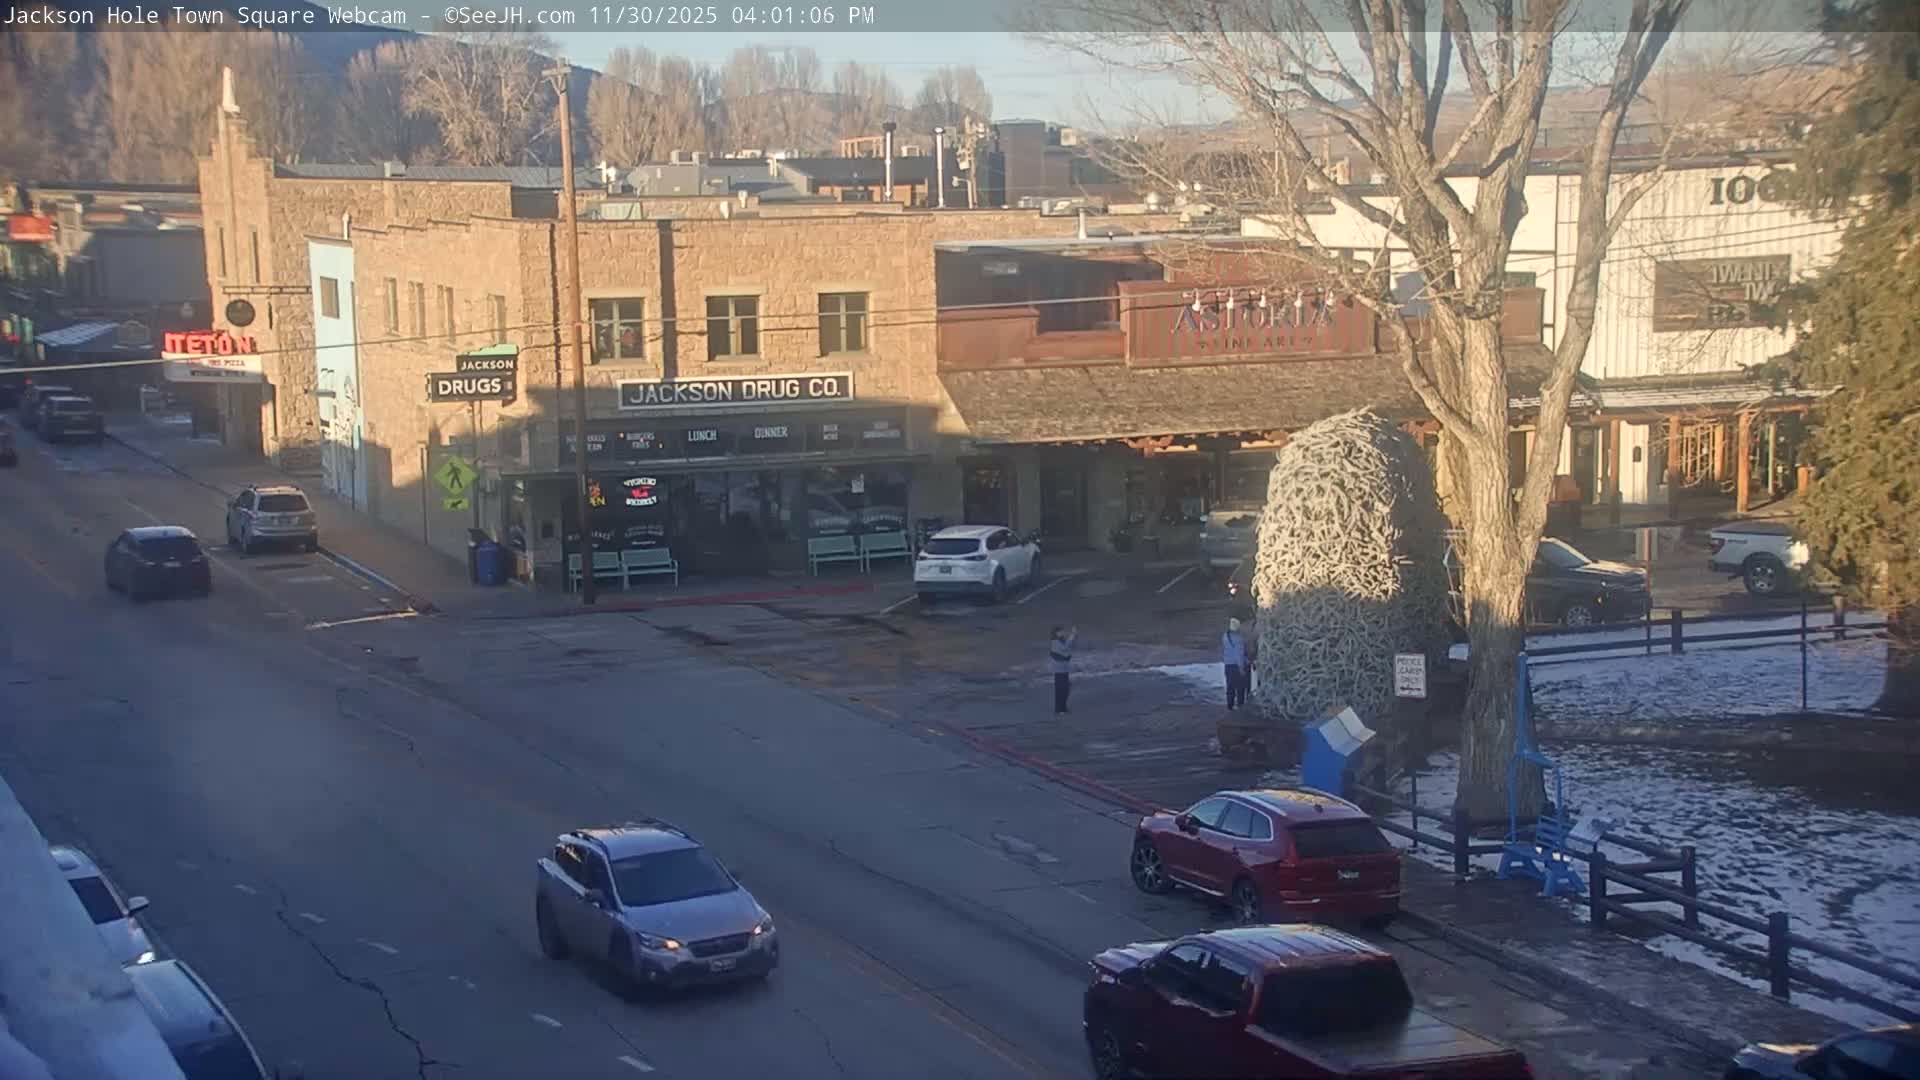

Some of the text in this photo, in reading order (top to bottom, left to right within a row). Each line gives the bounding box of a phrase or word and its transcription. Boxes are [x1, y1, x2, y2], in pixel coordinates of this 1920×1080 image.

[1172, 302, 1336, 333] ASTORIA
[461, 359, 514, 371] JACKSON
[438, 377, 502, 395] DRUGS
[630, 377, 842, 404] JACKSON DRUG CO.
[687, 429, 717, 442] LUNCH
[754, 426, 789, 439] DINNER
